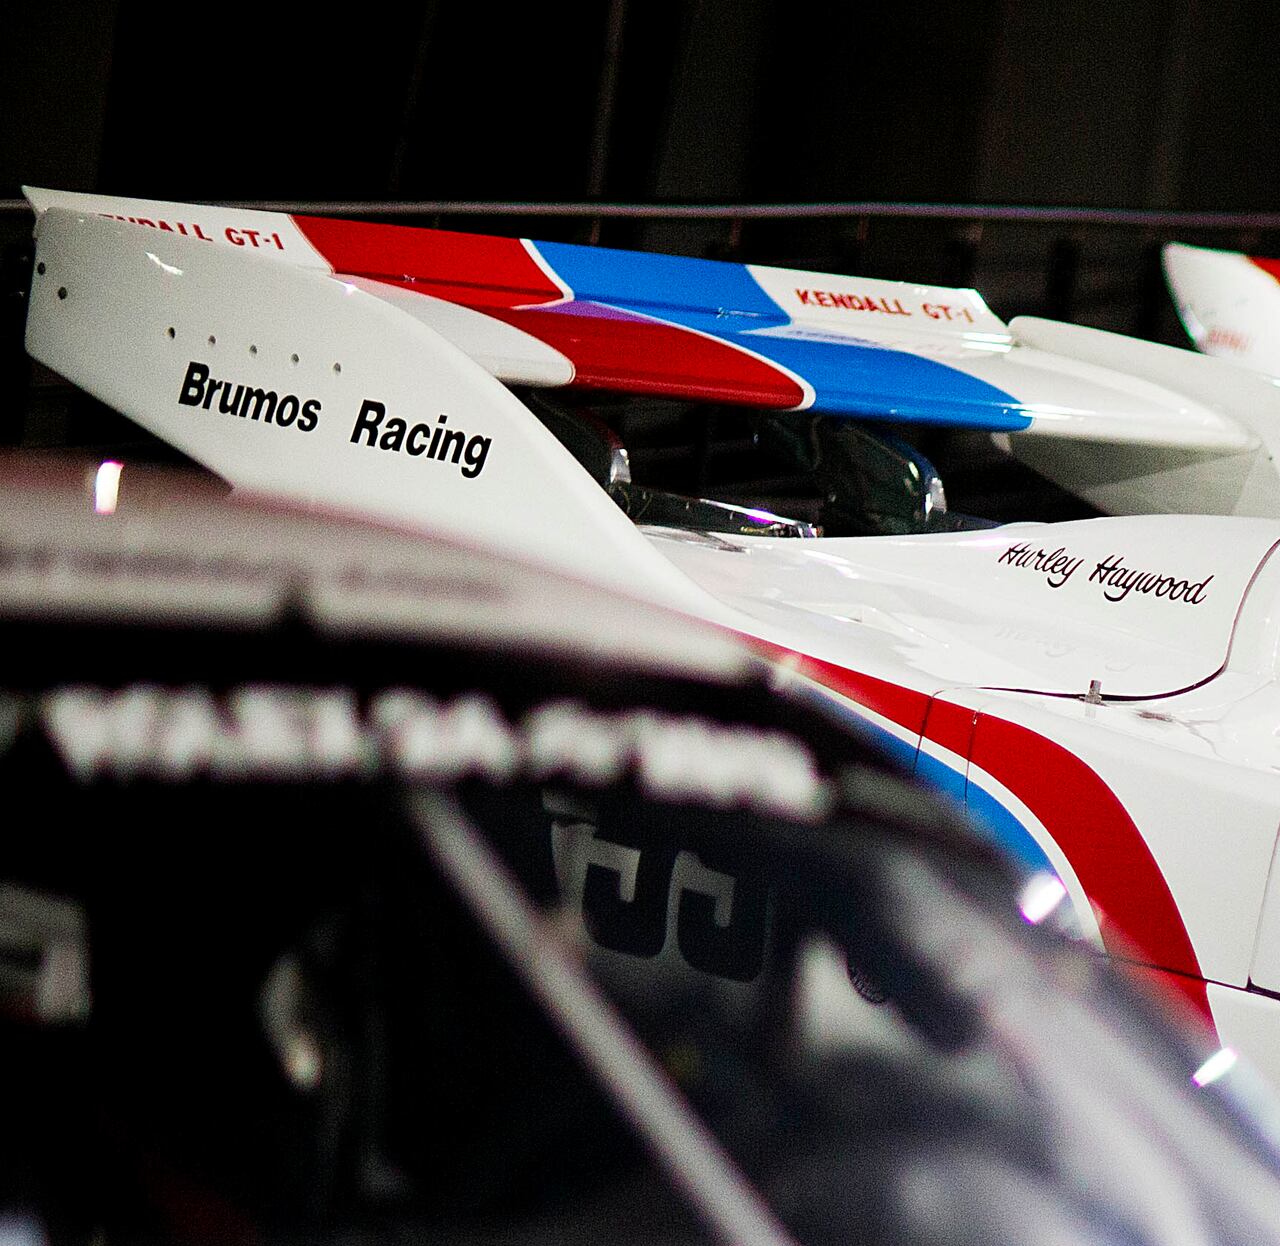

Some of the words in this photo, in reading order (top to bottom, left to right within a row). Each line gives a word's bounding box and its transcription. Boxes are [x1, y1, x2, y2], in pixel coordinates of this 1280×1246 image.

[224, 227, 284, 250] GT-1
[795, 288, 912, 317] KENDALL
[178, 361, 322, 432] Brumos
[349, 399, 493, 479] Racing
[998, 543, 1085, 588] Hurley
[1088, 554, 1215, 605] Haywood
